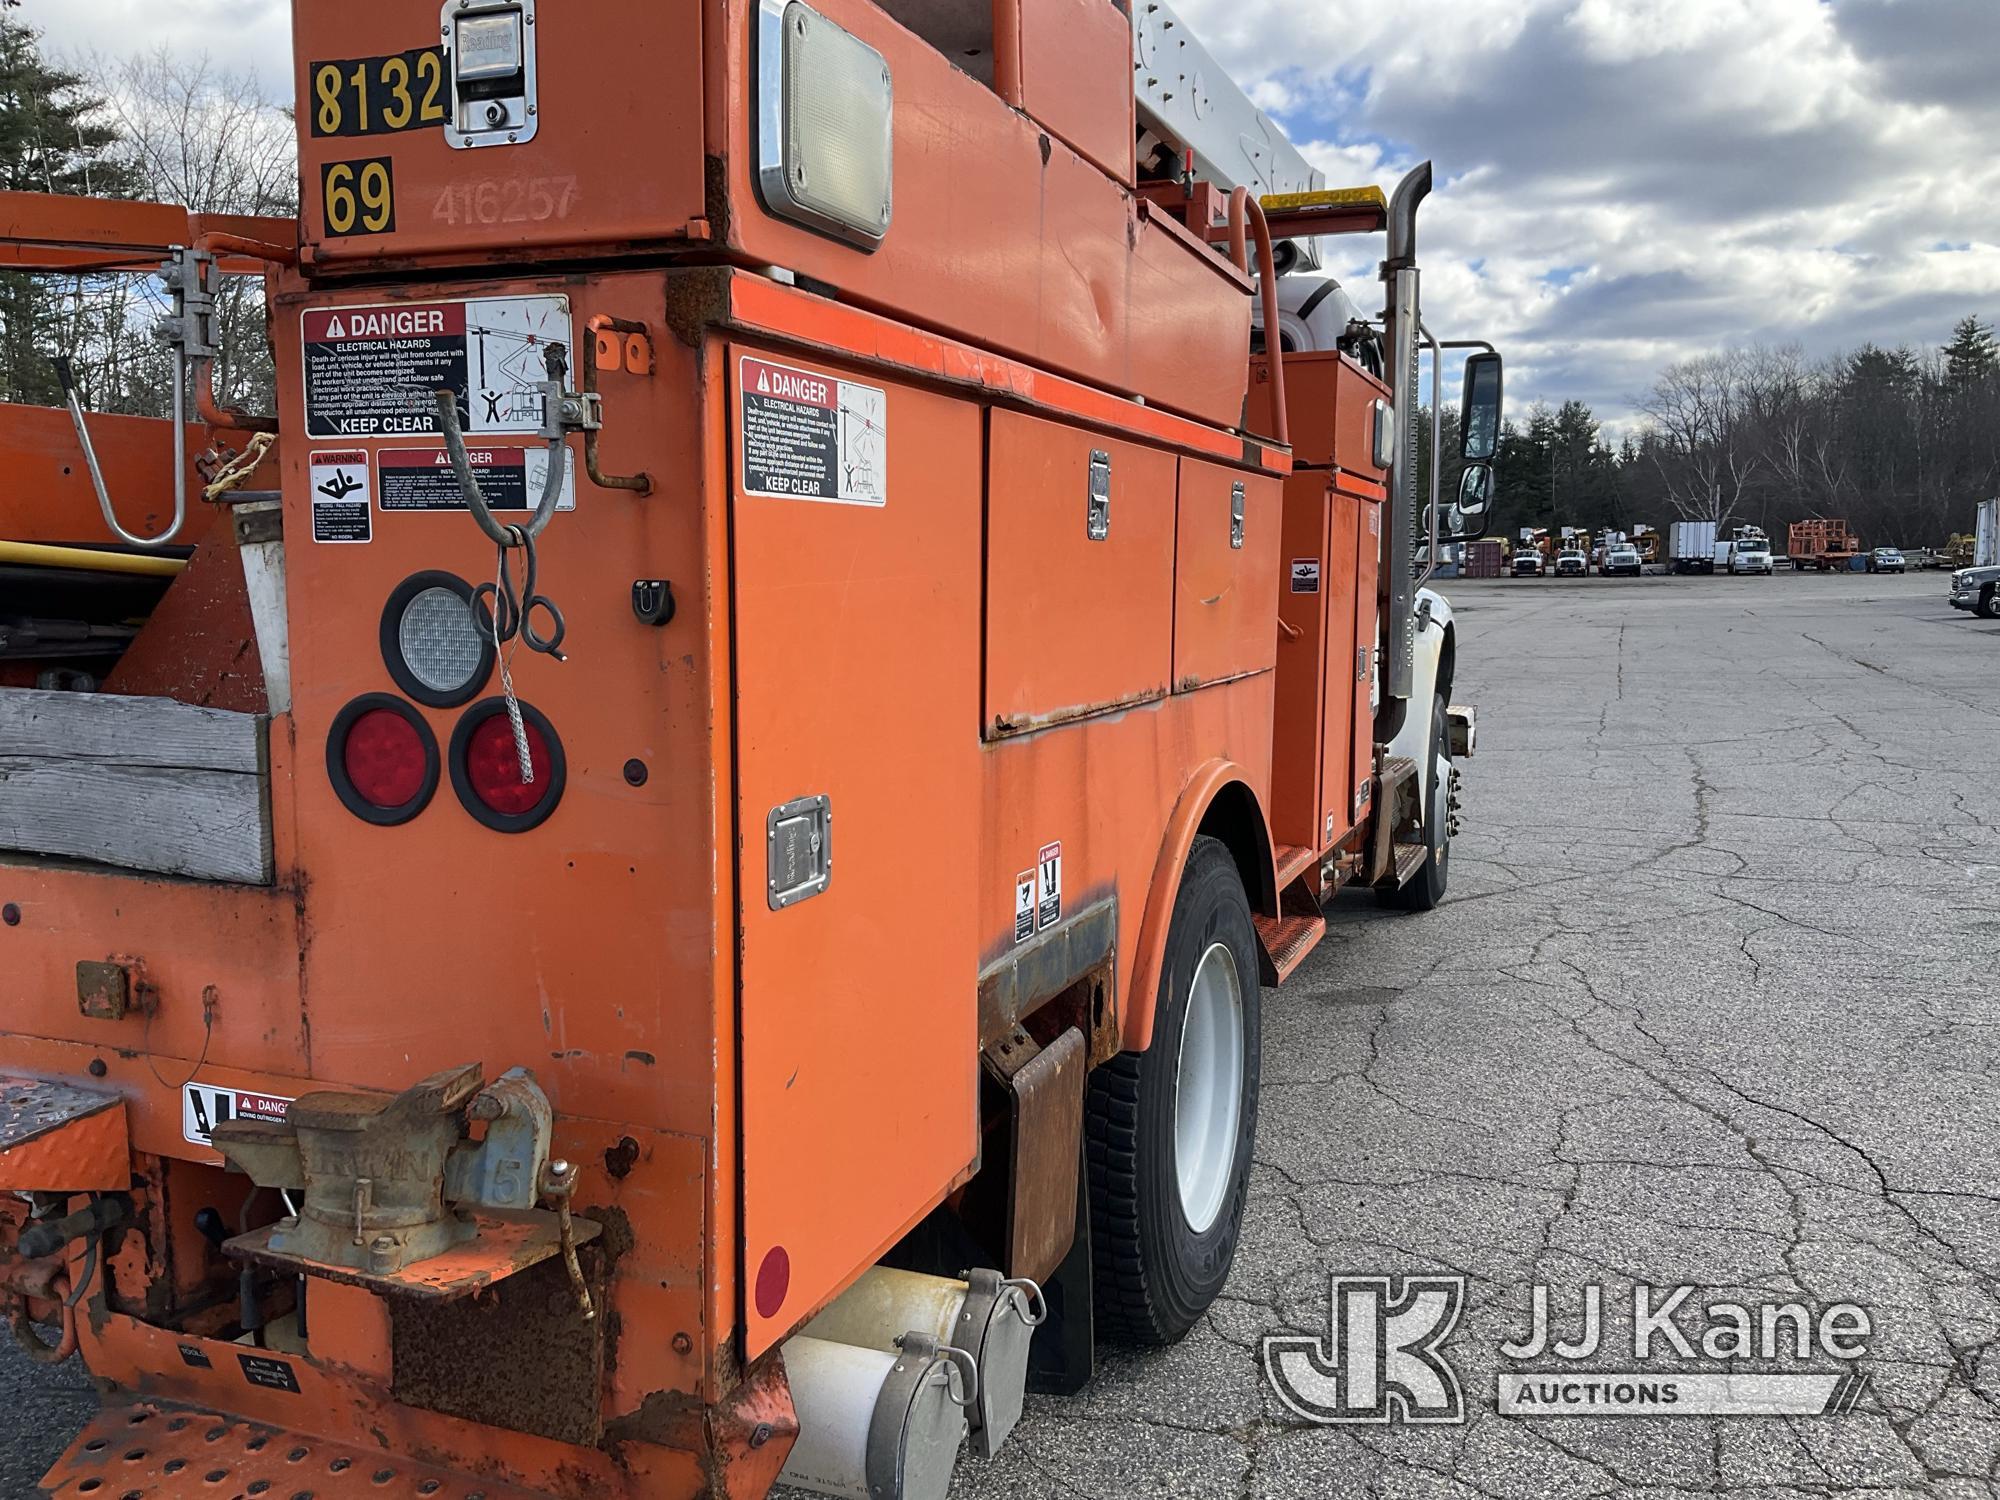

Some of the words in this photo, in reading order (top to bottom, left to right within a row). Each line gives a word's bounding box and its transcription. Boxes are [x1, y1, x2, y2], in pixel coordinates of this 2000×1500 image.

[315, 51, 444, 134] 8132
[325, 161, 391, 233] 69
[432, 175, 578, 225] 416257
[351, 310, 444, 336] DANGER
[337, 342, 388, 352] ELECTRICAL
[390, 339, 431, 349] HAZARDS
[396, 359, 433, 367] attachments
[384, 367, 415, 376] energized.
[362, 376, 396, 384] understand
[773, 373, 827, 404] DANGER
[342, 401, 369, 409] approach
[764, 399, 795, 413] ELECTRICAL
[796, 405, 819, 417] HAZARDS
[341, 418, 379, 432] KEEP
[383, 417, 433, 431] CLEAR
[322, 454, 363, 463] WARNING
[765, 476, 789, 491] KEEP
[792, 479, 820, 495] CLEAR
[258, 1099, 289, 1114] DANG
[239, 1111, 256, 1120] MOVING
[312, 1147, 432, 1182] IRWIN
